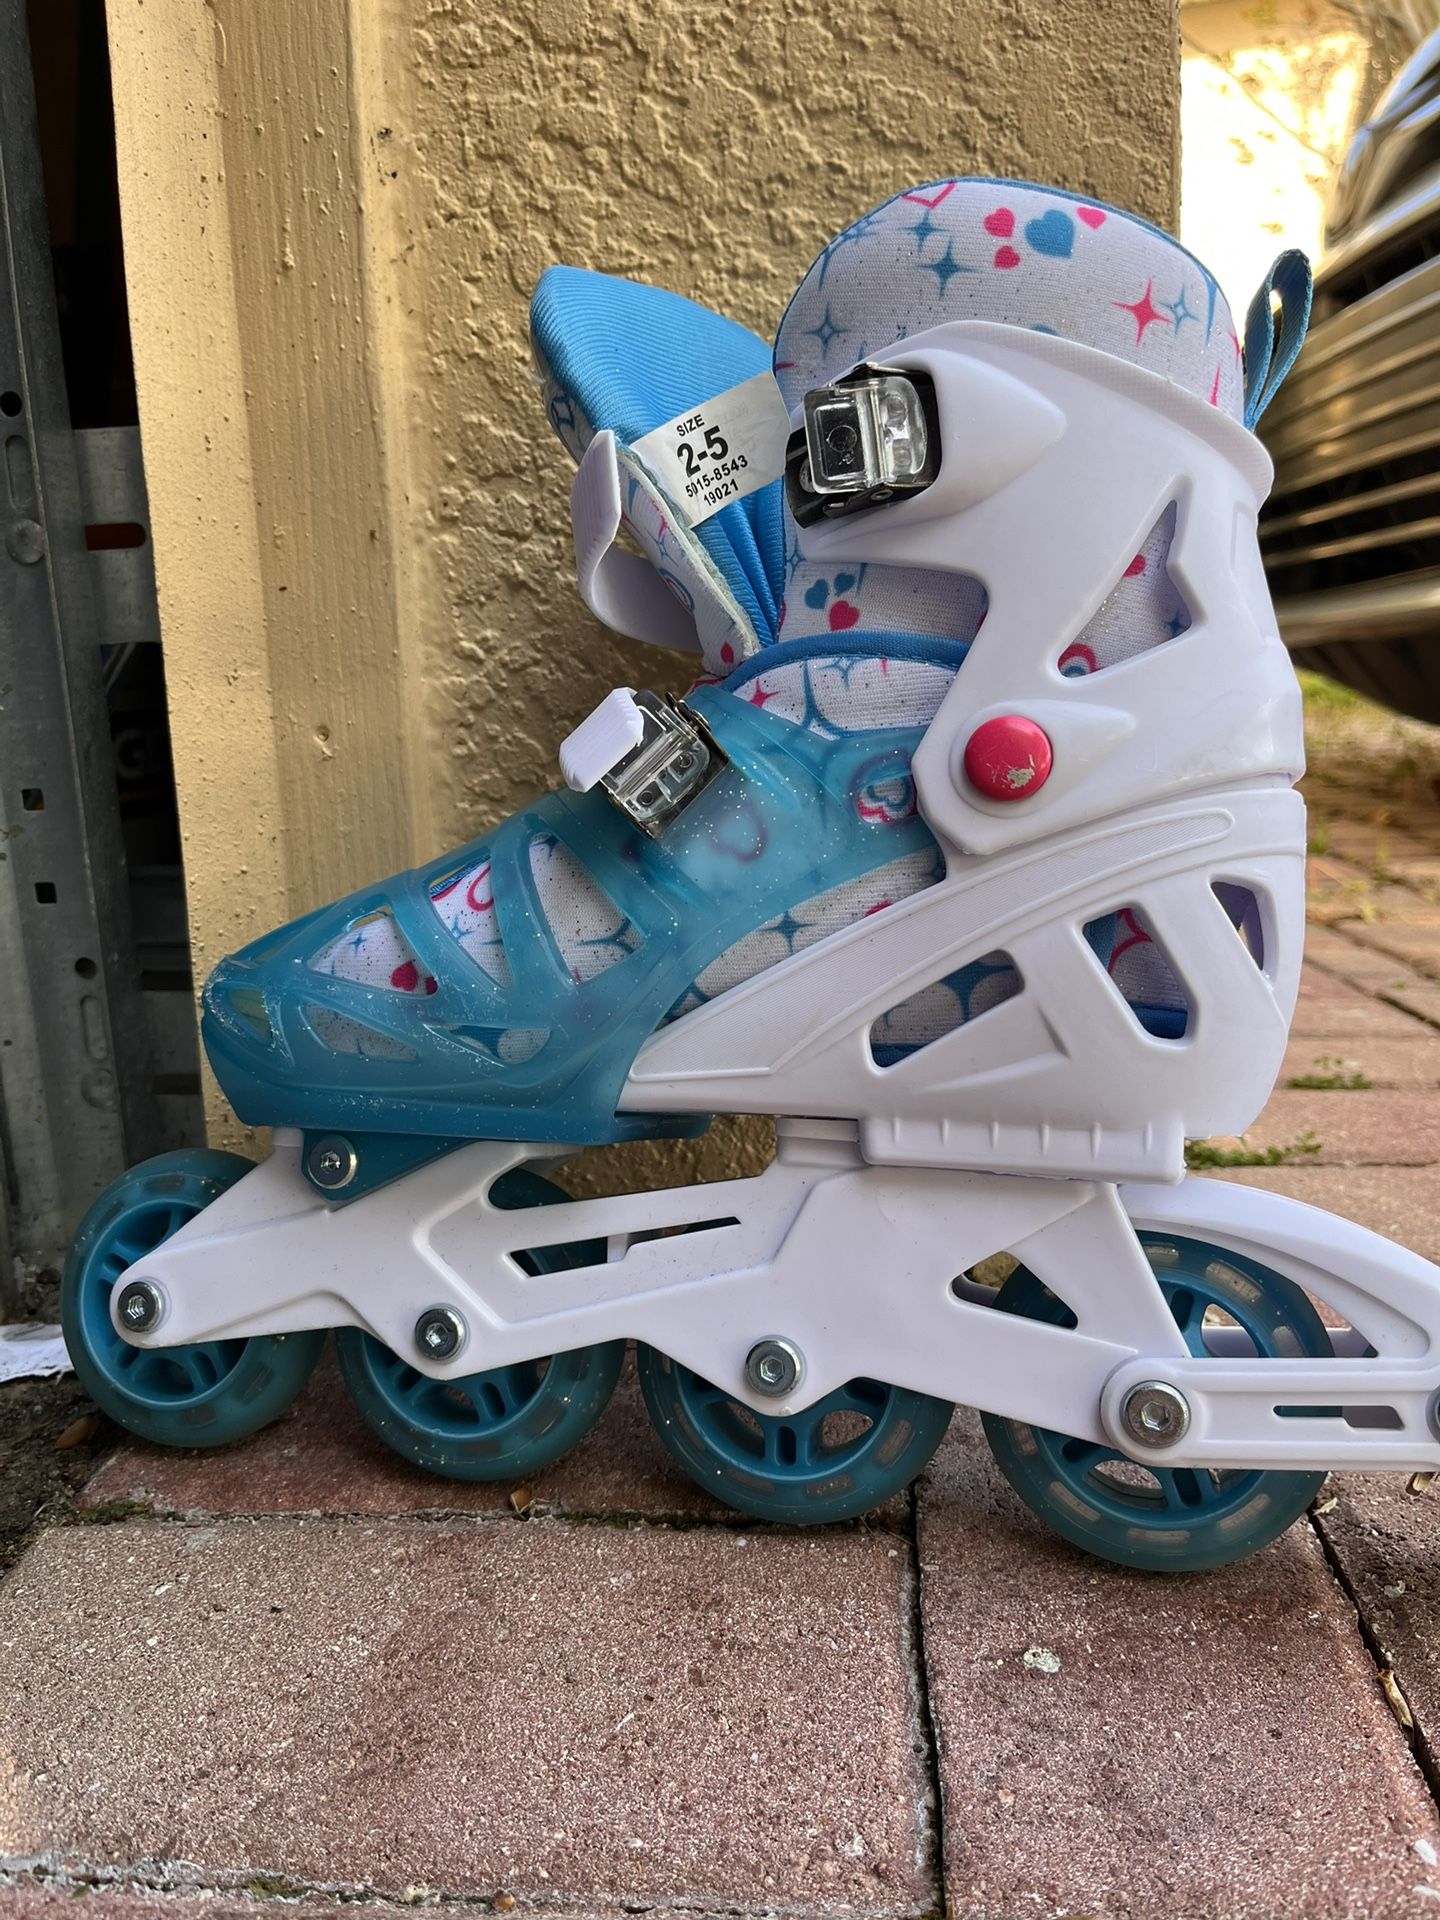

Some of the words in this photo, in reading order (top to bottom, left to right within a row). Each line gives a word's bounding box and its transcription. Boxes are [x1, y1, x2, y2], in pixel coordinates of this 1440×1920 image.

[676, 414, 705, 437] SIZE
[677, 425, 729, 478] 2-5
[685, 454, 748, 498] 5015-8543
[703, 478, 739, 506] 19021
